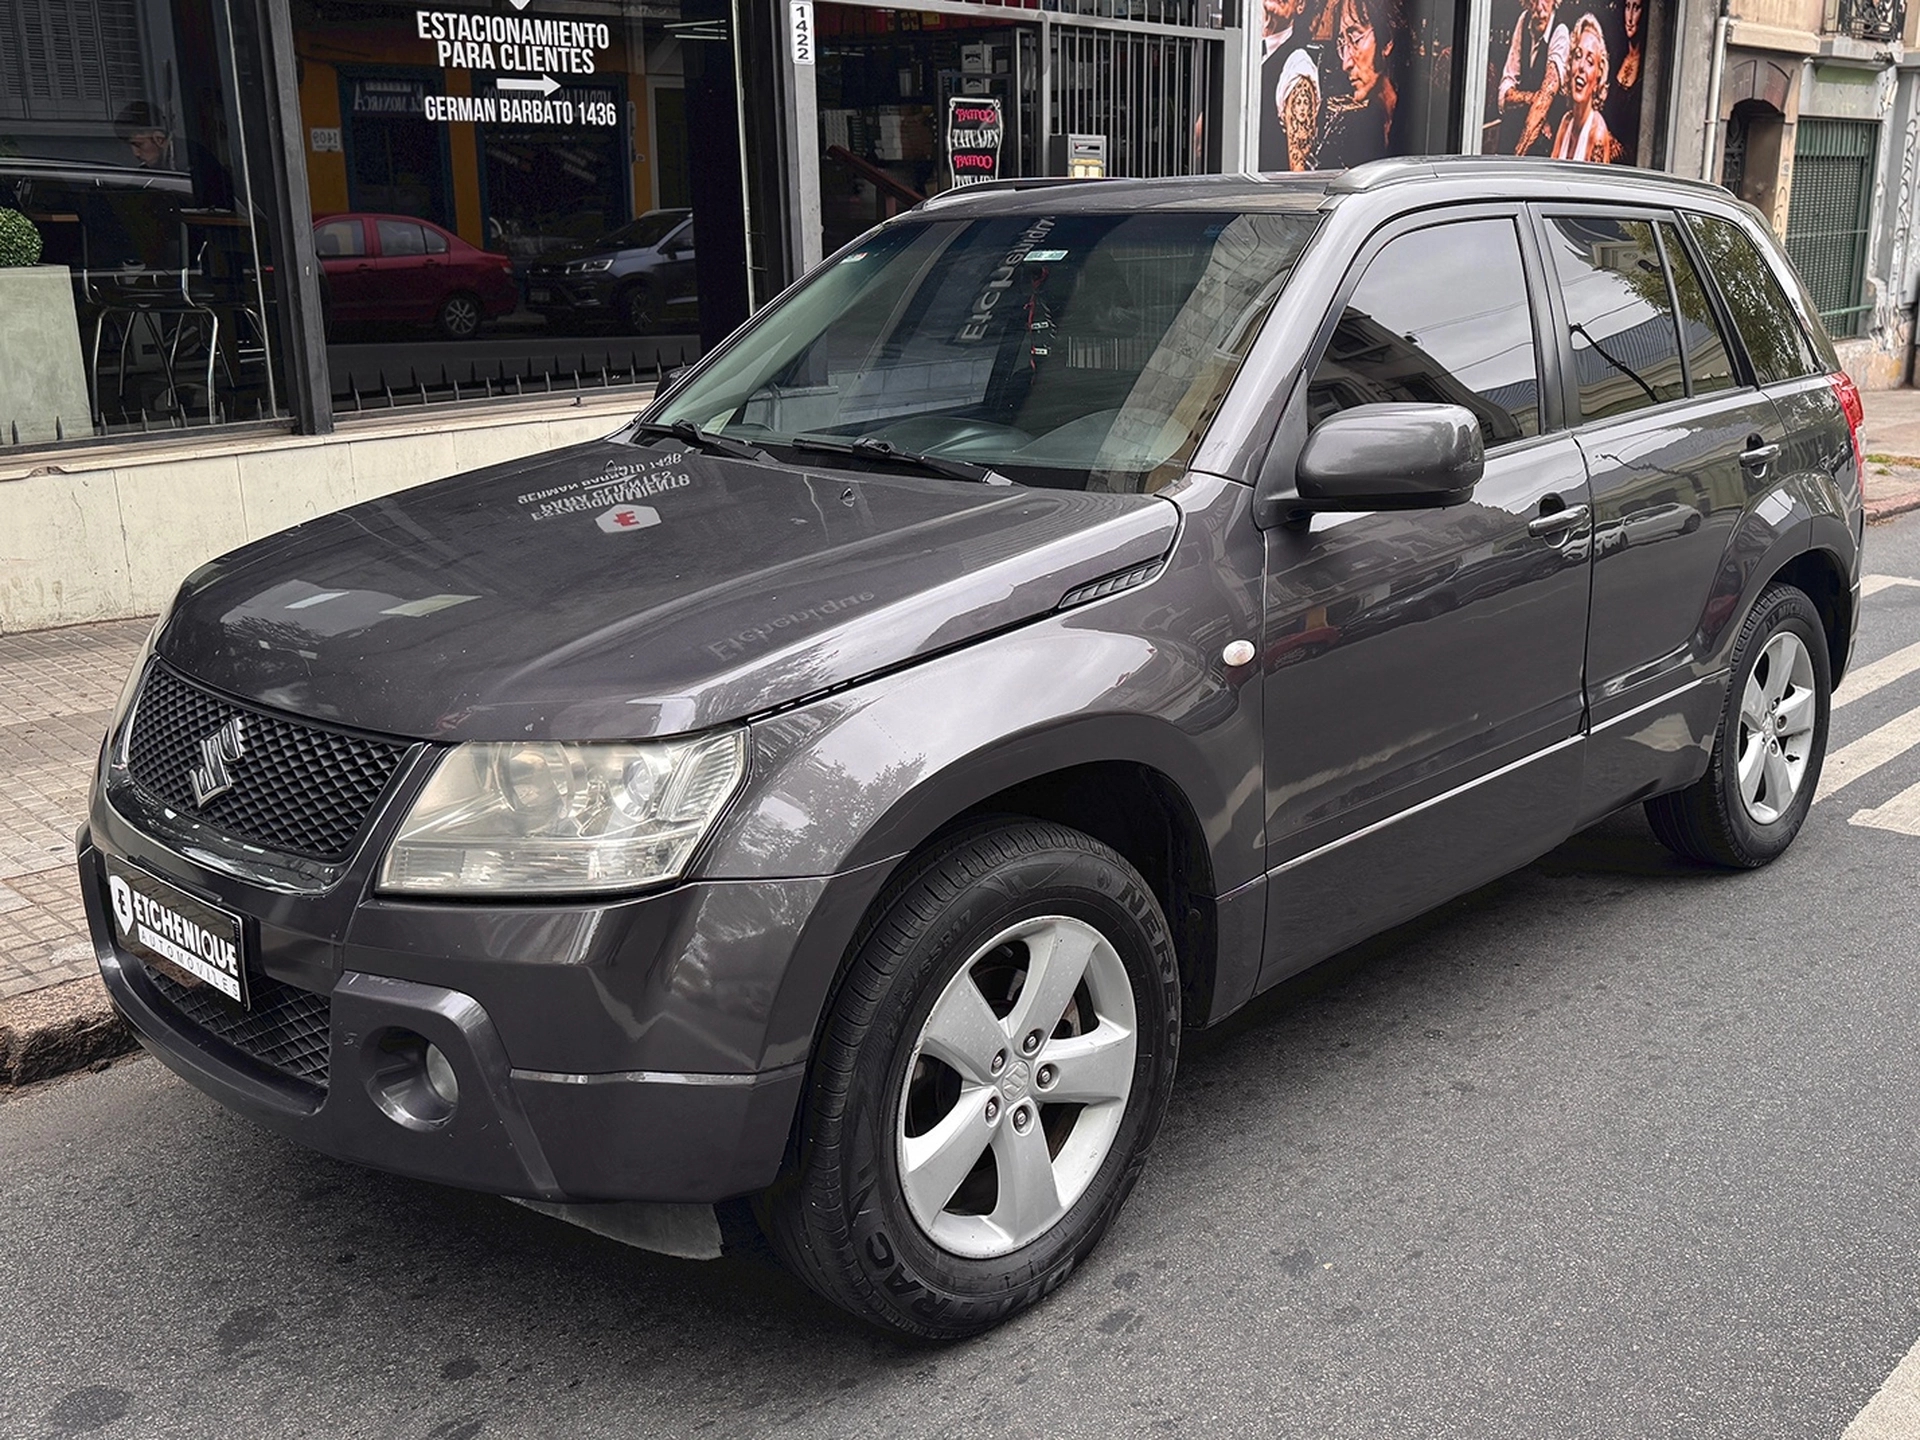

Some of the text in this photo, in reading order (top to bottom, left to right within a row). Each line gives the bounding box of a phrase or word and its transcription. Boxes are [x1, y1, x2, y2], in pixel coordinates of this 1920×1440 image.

[416, 10, 610, 50] ESTACIONAMIENTO
[794, 5, 811, 60] 1422
[437, 40, 596, 74] PARA CLIENTES
[424, 95, 617, 126] GERMAN BARBATO 1436
[955, 108, 997, 124] TATTOO
[953, 154, 994, 169] TATTOO
[133, 890, 239, 977] ETCHENIQUE
[140, 929, 240, 999] AUTOMOVILES
